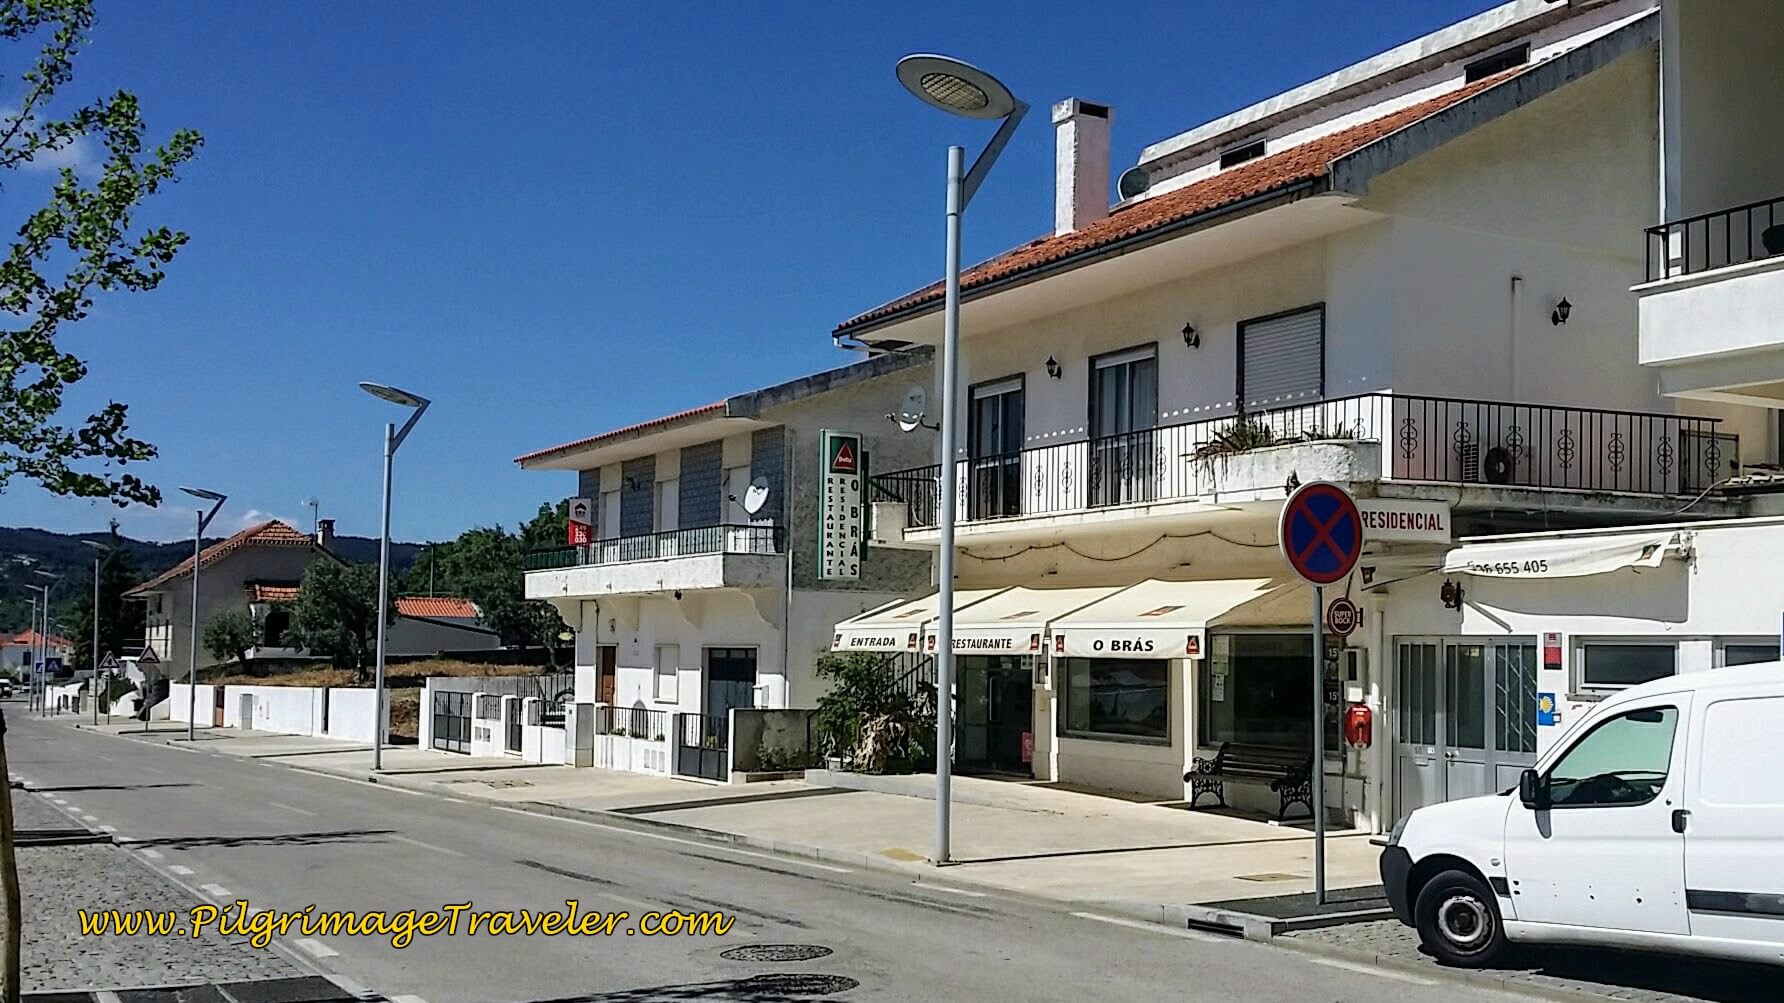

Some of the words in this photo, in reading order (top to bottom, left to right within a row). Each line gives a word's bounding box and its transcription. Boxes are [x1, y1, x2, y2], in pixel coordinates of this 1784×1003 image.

[850, 479, 859, 492] O
[826, 477, 834, 576] RESTAURANTE
[838, 477, 846, 576] RESIDENCIAL
[1361, 510, 1444, 531] RESIDENCIAL
[850, 506, 859, 576] BRÁS
[1494, 561, 1520, 575] 655
[1523, 559, 1548, 574] 405
[1333, 610, 1352, 618] SUPER
[1334, 617, 1351, 625] BOCK
[850, 637, 896, 647] ENTRADA
[1093, 639, 1104, 651] O
[1110, 637, 1154, 652] BRÁS
